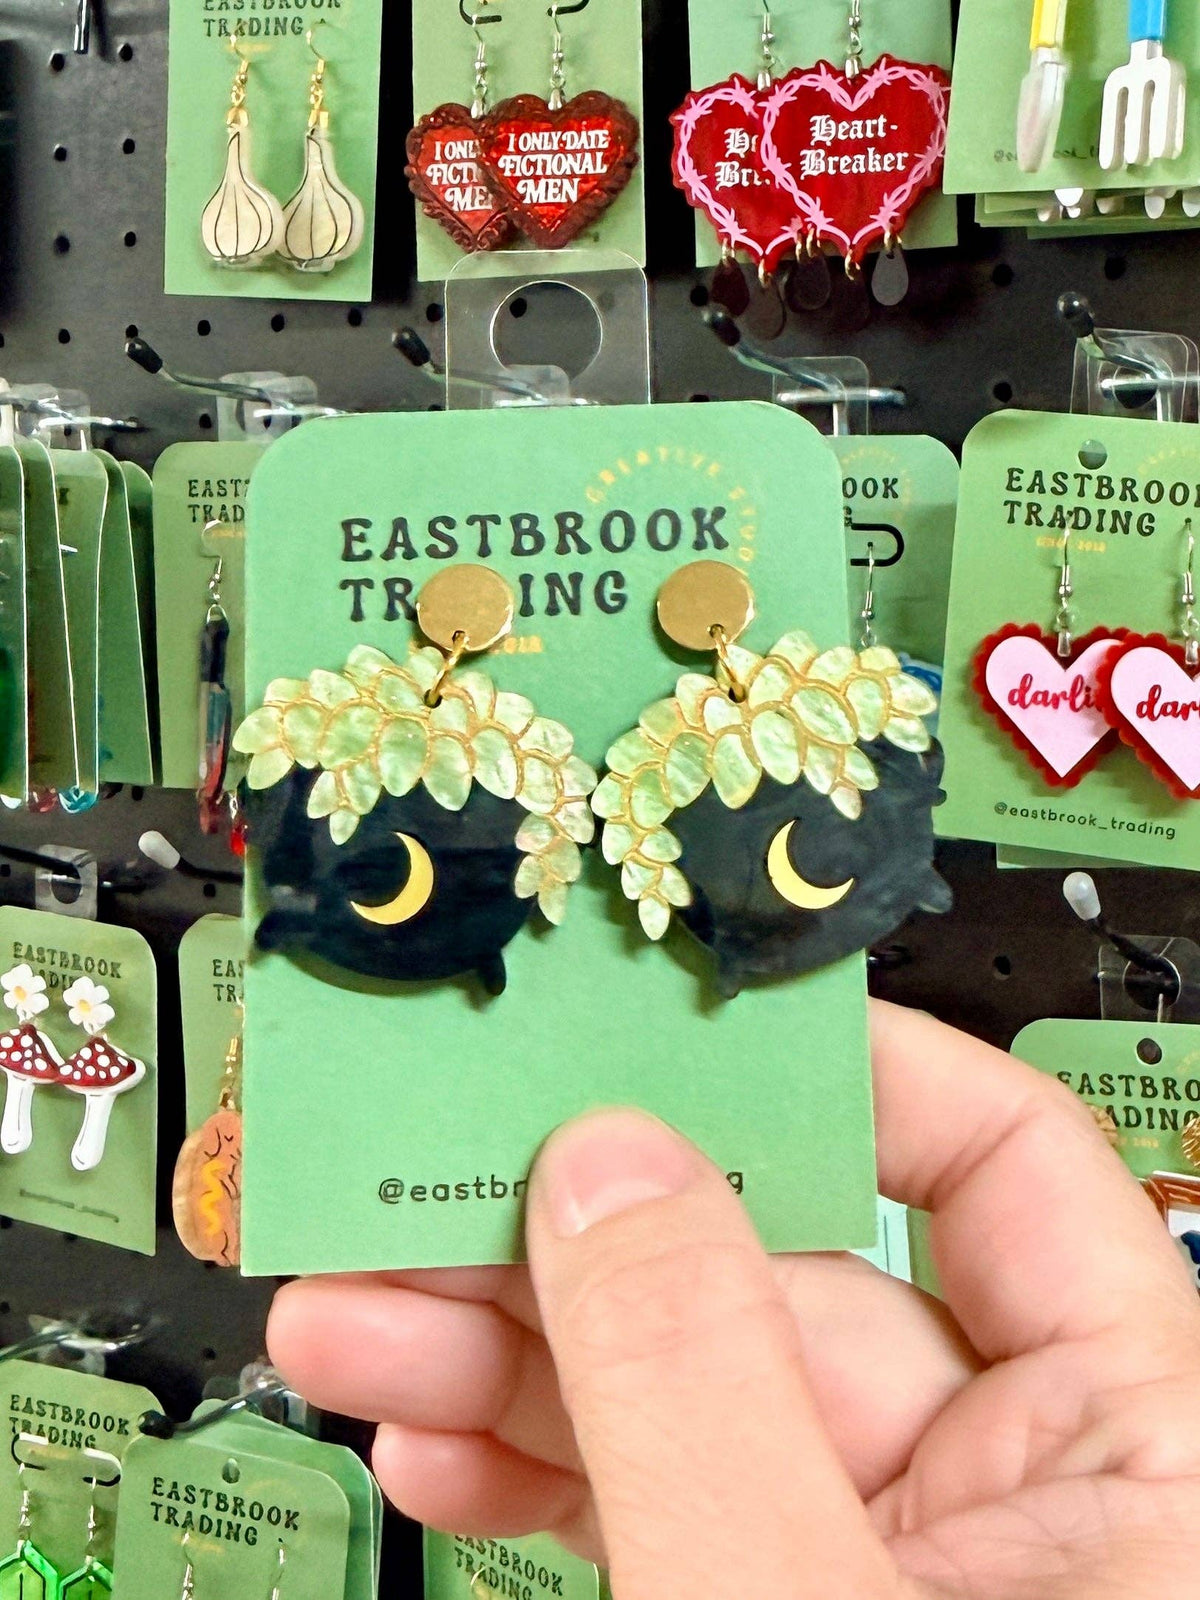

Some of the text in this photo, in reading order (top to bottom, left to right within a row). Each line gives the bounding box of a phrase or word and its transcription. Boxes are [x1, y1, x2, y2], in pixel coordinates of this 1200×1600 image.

[203, 16, 304, 37] TRADING
[508, 130, 610, 152] I ONLY DATE
[809, 114, 898, 146] Heart-
[426, 162, 482, 186] FICTI
[498, 152, 608, 177] FICTIONAL
[800, 147, 909, 180] Breaker
[517, 178, 581, 204] MEN
[1005, 467, 1200, 508] EASTBROO
[341, 506, 730, 562] EASTBROOK
[1003, 500, 1156, 537] TRADING
[339, 570, 628, 622] TRING
[1135, 684, 1200, 721] dar
[994, 802, 1176, 840] @eastbrook_trading
[12, 941, 122, 979] EASTBROOK
[9, 1416, 96, 1449] TRADING
[10, 1394, 130, 1436] EASTBROOK
[152, 1476, 300, 1531] EASTBROOK
[150, 1502, 258, 1546] TRADING
